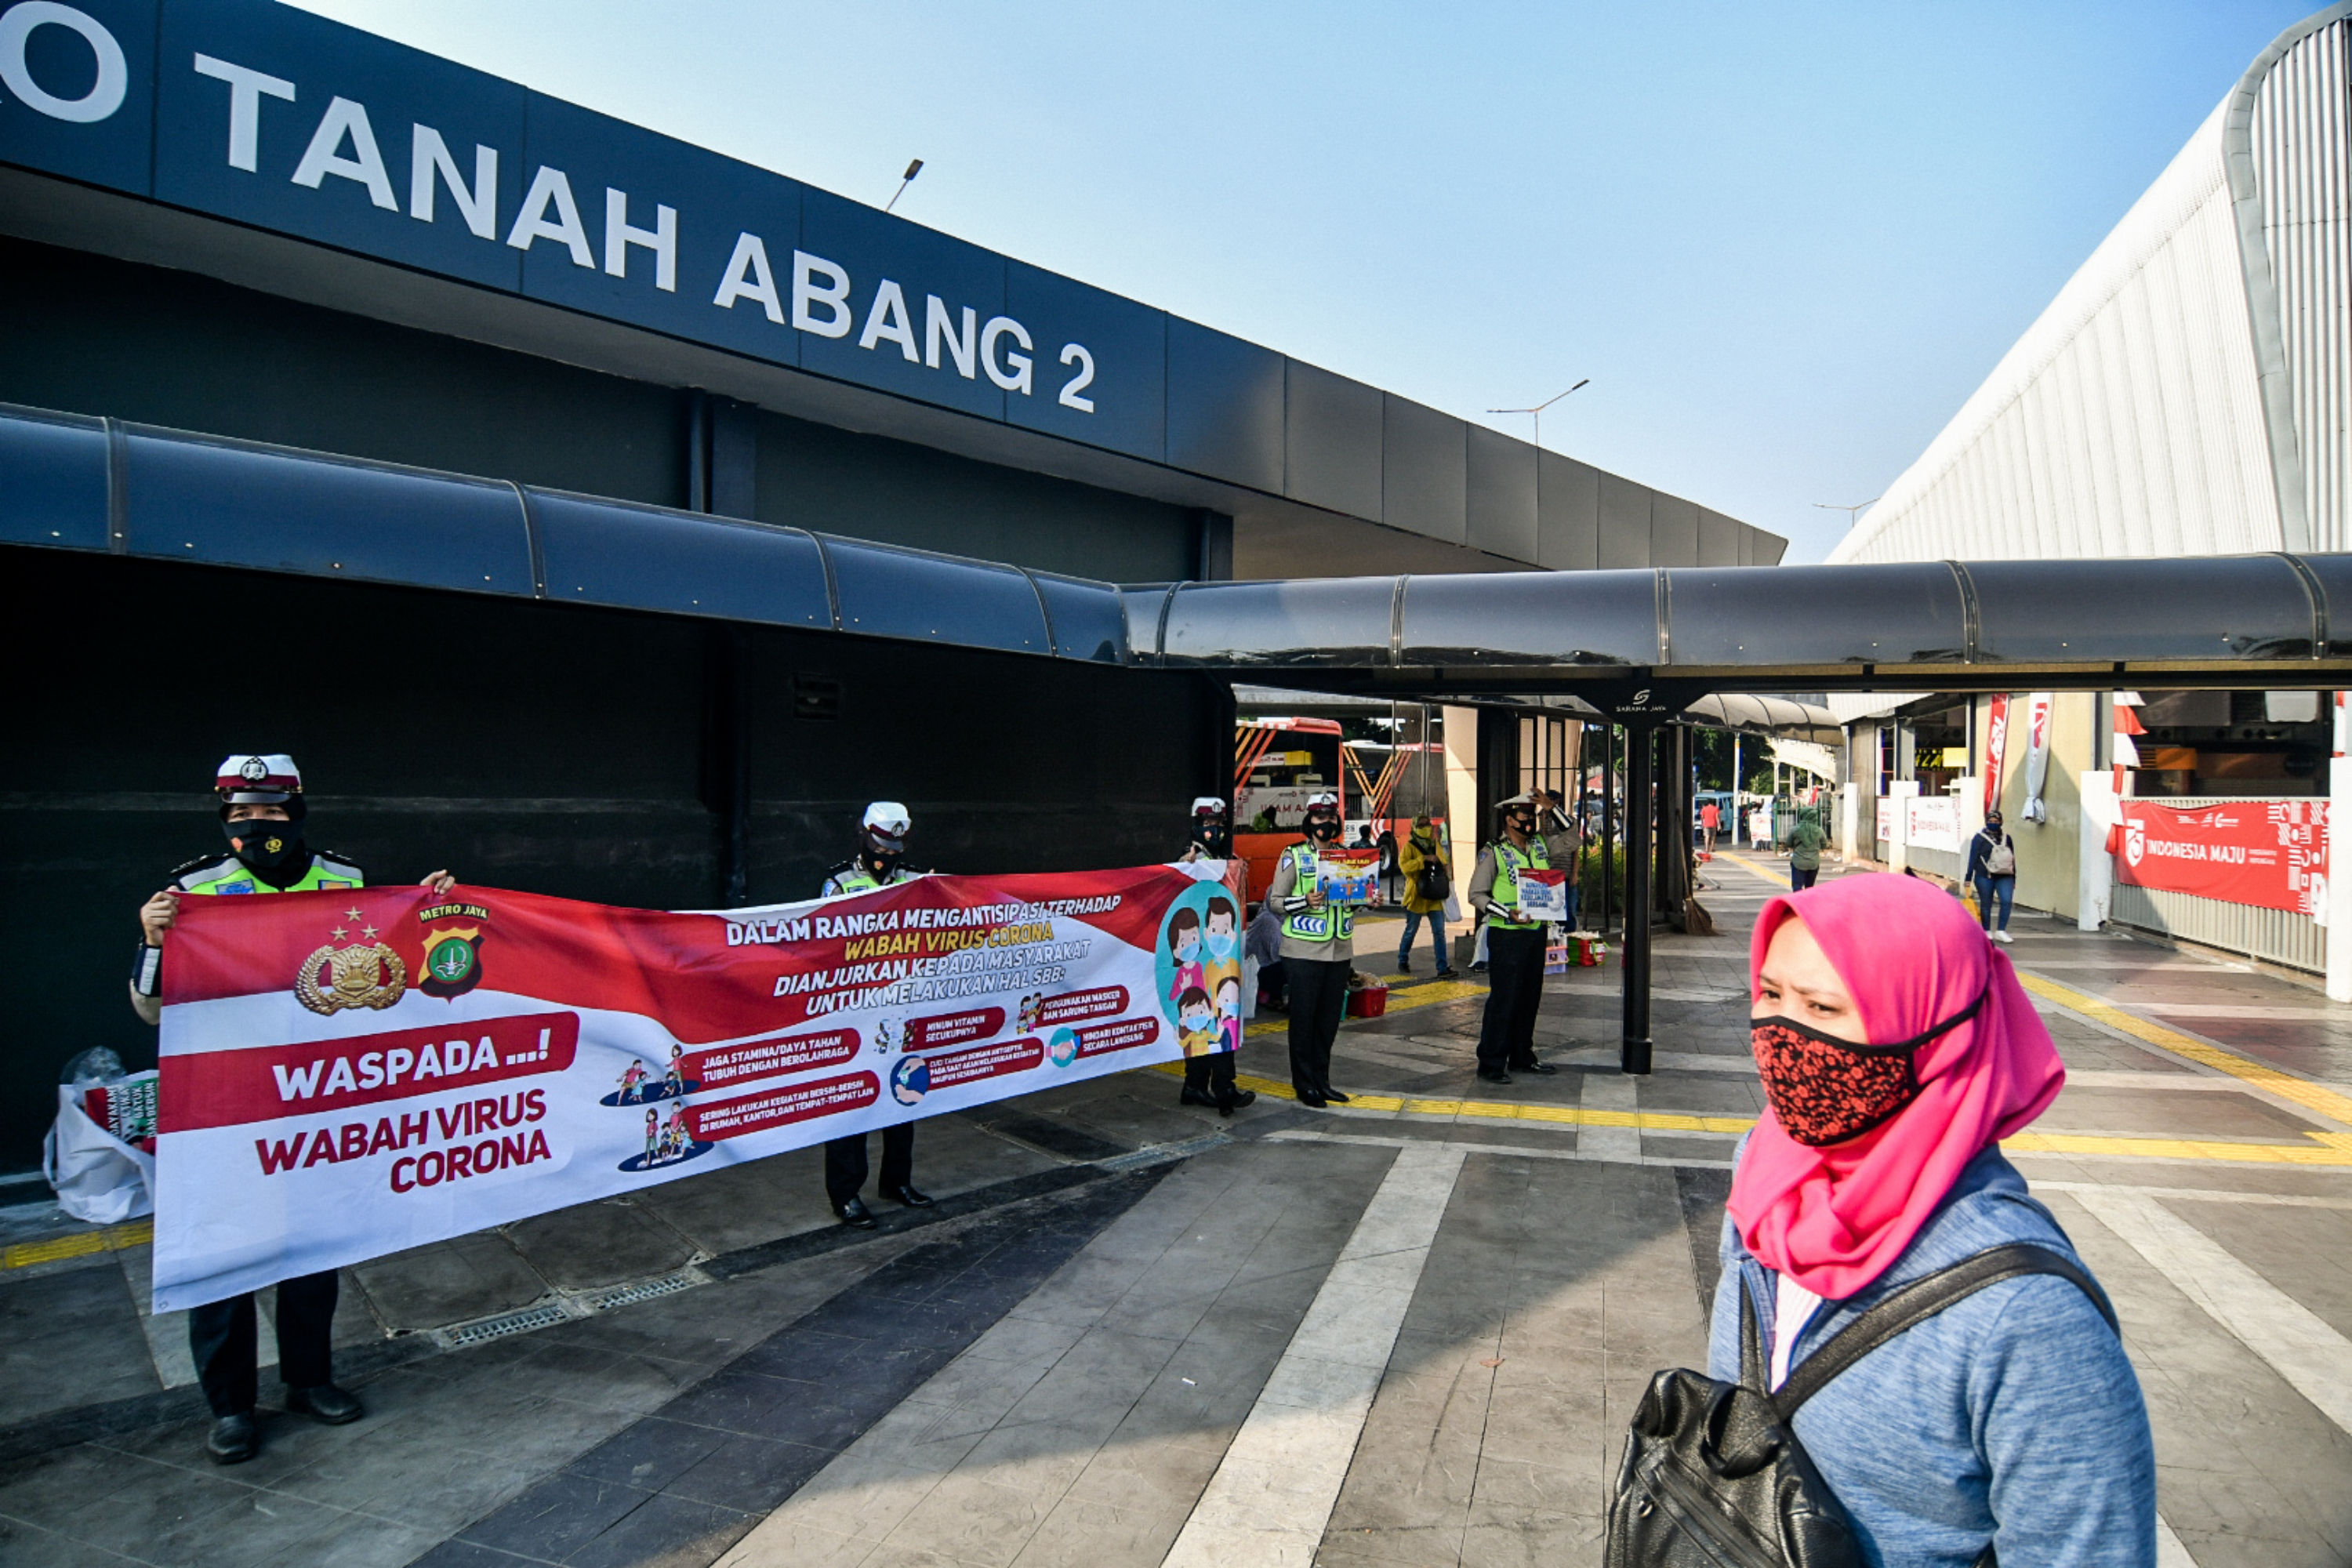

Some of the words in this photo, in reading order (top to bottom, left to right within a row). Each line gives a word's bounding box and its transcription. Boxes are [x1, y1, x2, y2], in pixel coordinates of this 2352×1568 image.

[194, 52, 677, 292] TANAH
[713, 231, 1033, 395] ABANG
[1058, 343, 1094, 413] 2
[2146, 838, 2206, 861] INDONESIA
[2209, 844, 2245, 864] MAJU
[419, 904, 461, 921] METRO
[463, 906, 487, 918] JAYA
[726, 918, 811, 946] DALAM
[815, 913, 899, 939] RANGKA
[902, 902, 1045, 928] MENGANTISIPASI
[1046, 895, 1121, 917] TERHADAP
[844, 931, 920, 961] WABAH
[925, 928, 985, 952] VIRUS
[988, 920, 1054, 949] CORONA
[772, 959, 908, 996] DIANJURKAN
[911, 952, 984, 978] KEPADA
[988, 939, 1091, 969] MASYARAKAT
[806, 986, 879, 1015] UNTUK
[881, 975, 996, 1006] MELAKUKAN
[997, 970, 1029, 992] HAL
[1032, 966, 1065, 985] SBB:
[273, 1036, 499, 1102] WASPADA
[702, 1054, 729, 1069] JAGA
[731, 1041, 806, 1063] STAMINA/DAYA
[808, 1036, 841, 1049] TAHAN
[702, 1066, 737, 1082] TUBUH
[739, 1058, 779, 1075] DENGAN
[781, 1046, 849, 1066] BEROLAHRAGA
[699, 1108, 730, 1122] SERING
[731, 1099, 768, 1115] LAKUKAN
[770, 1091, 809, 1106] KEGIATAN
[699, 1123, 709, 1133] DI
[858, 1087, 874, 1098] LAIN
[256, 1110, 429, 1175] WABAH
[435, 1088, 546, 1140] VIRUS
[390, 1129, 552, 1193] CORONA
